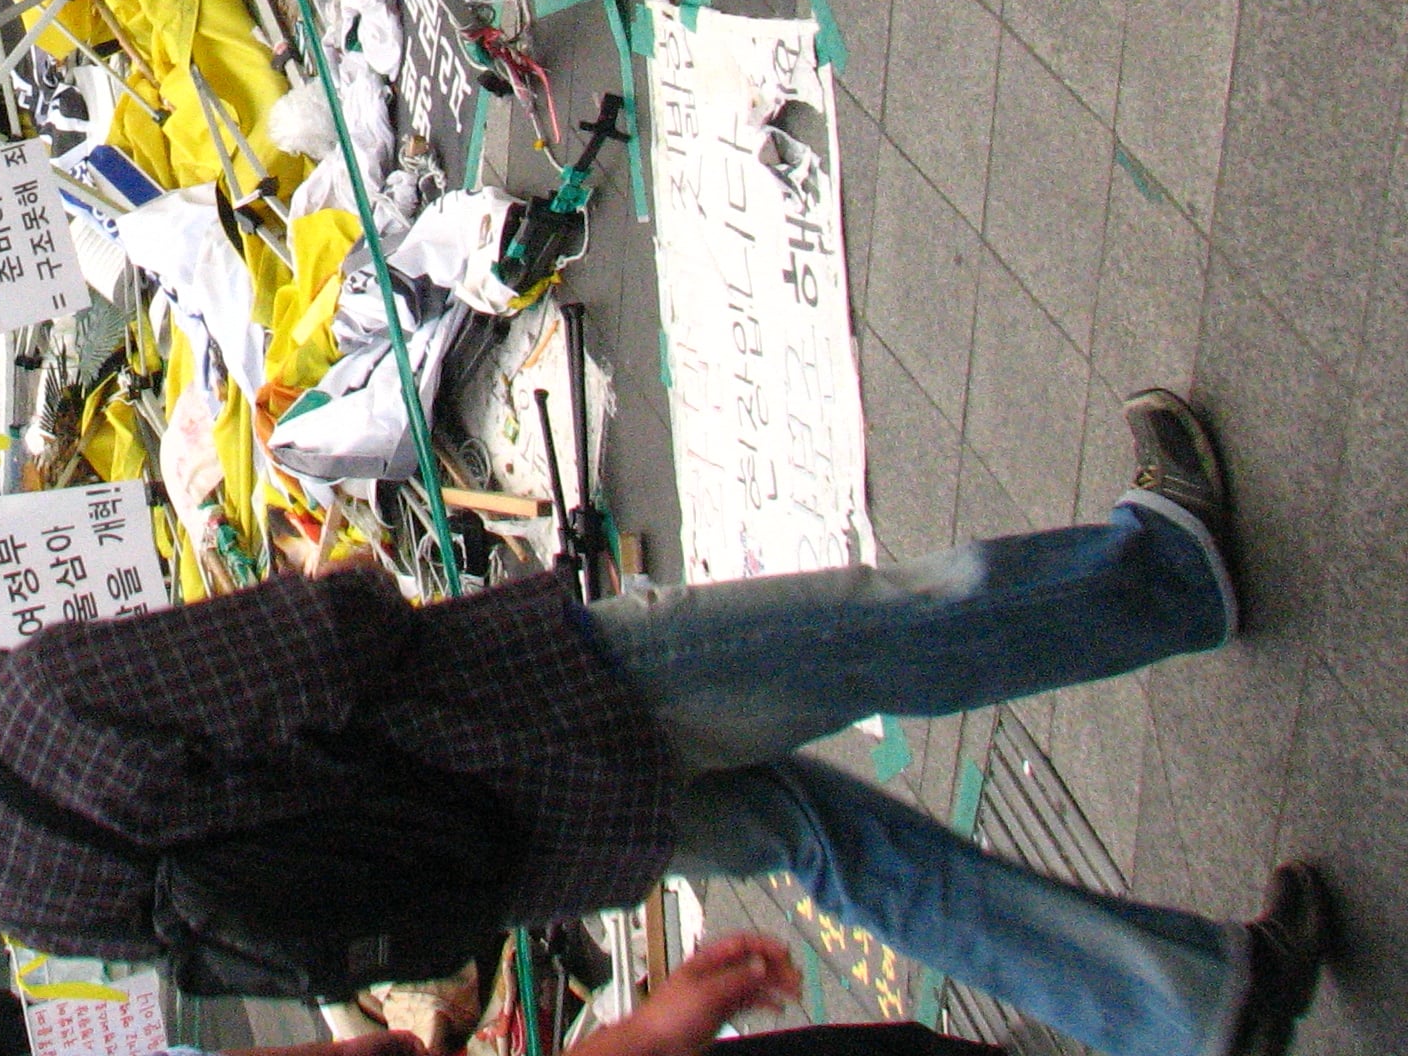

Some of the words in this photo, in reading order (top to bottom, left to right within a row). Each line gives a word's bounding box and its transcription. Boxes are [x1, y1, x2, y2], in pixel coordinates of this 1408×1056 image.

[11, 179, 63, 282] 구조못해
[718, 112, 779, 511] 현장입니다
[85, 486, 127, 548] 개혁!
